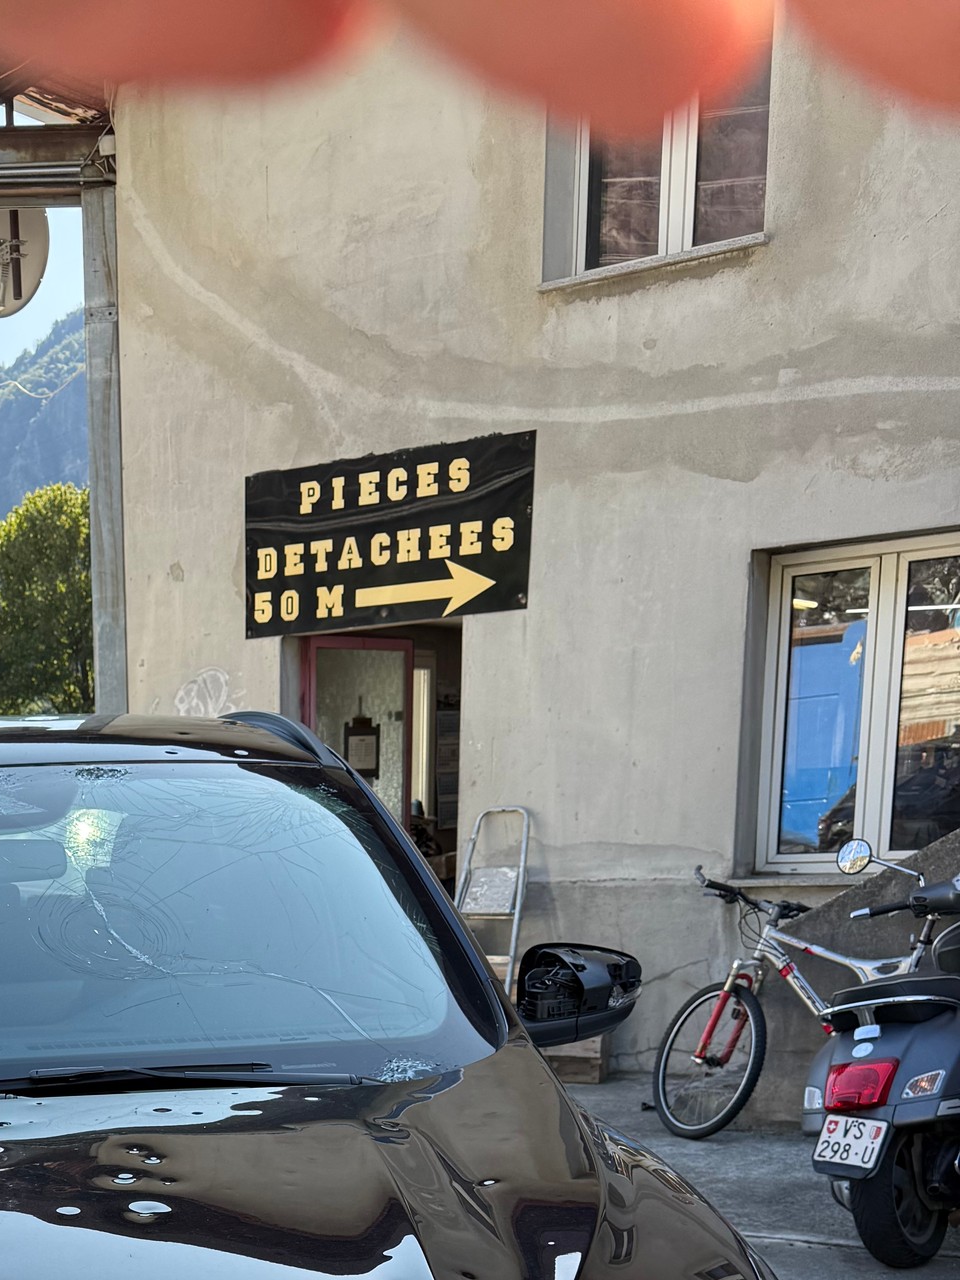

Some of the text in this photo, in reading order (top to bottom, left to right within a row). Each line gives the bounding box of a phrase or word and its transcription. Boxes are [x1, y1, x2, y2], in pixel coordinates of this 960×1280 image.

[299, 457, 471, 515] PIECES
[256, 516, 515, 580] DETACHEES
[253, 584, 345, 624] 50 M
[843, 1119, 866, 1140] VS
